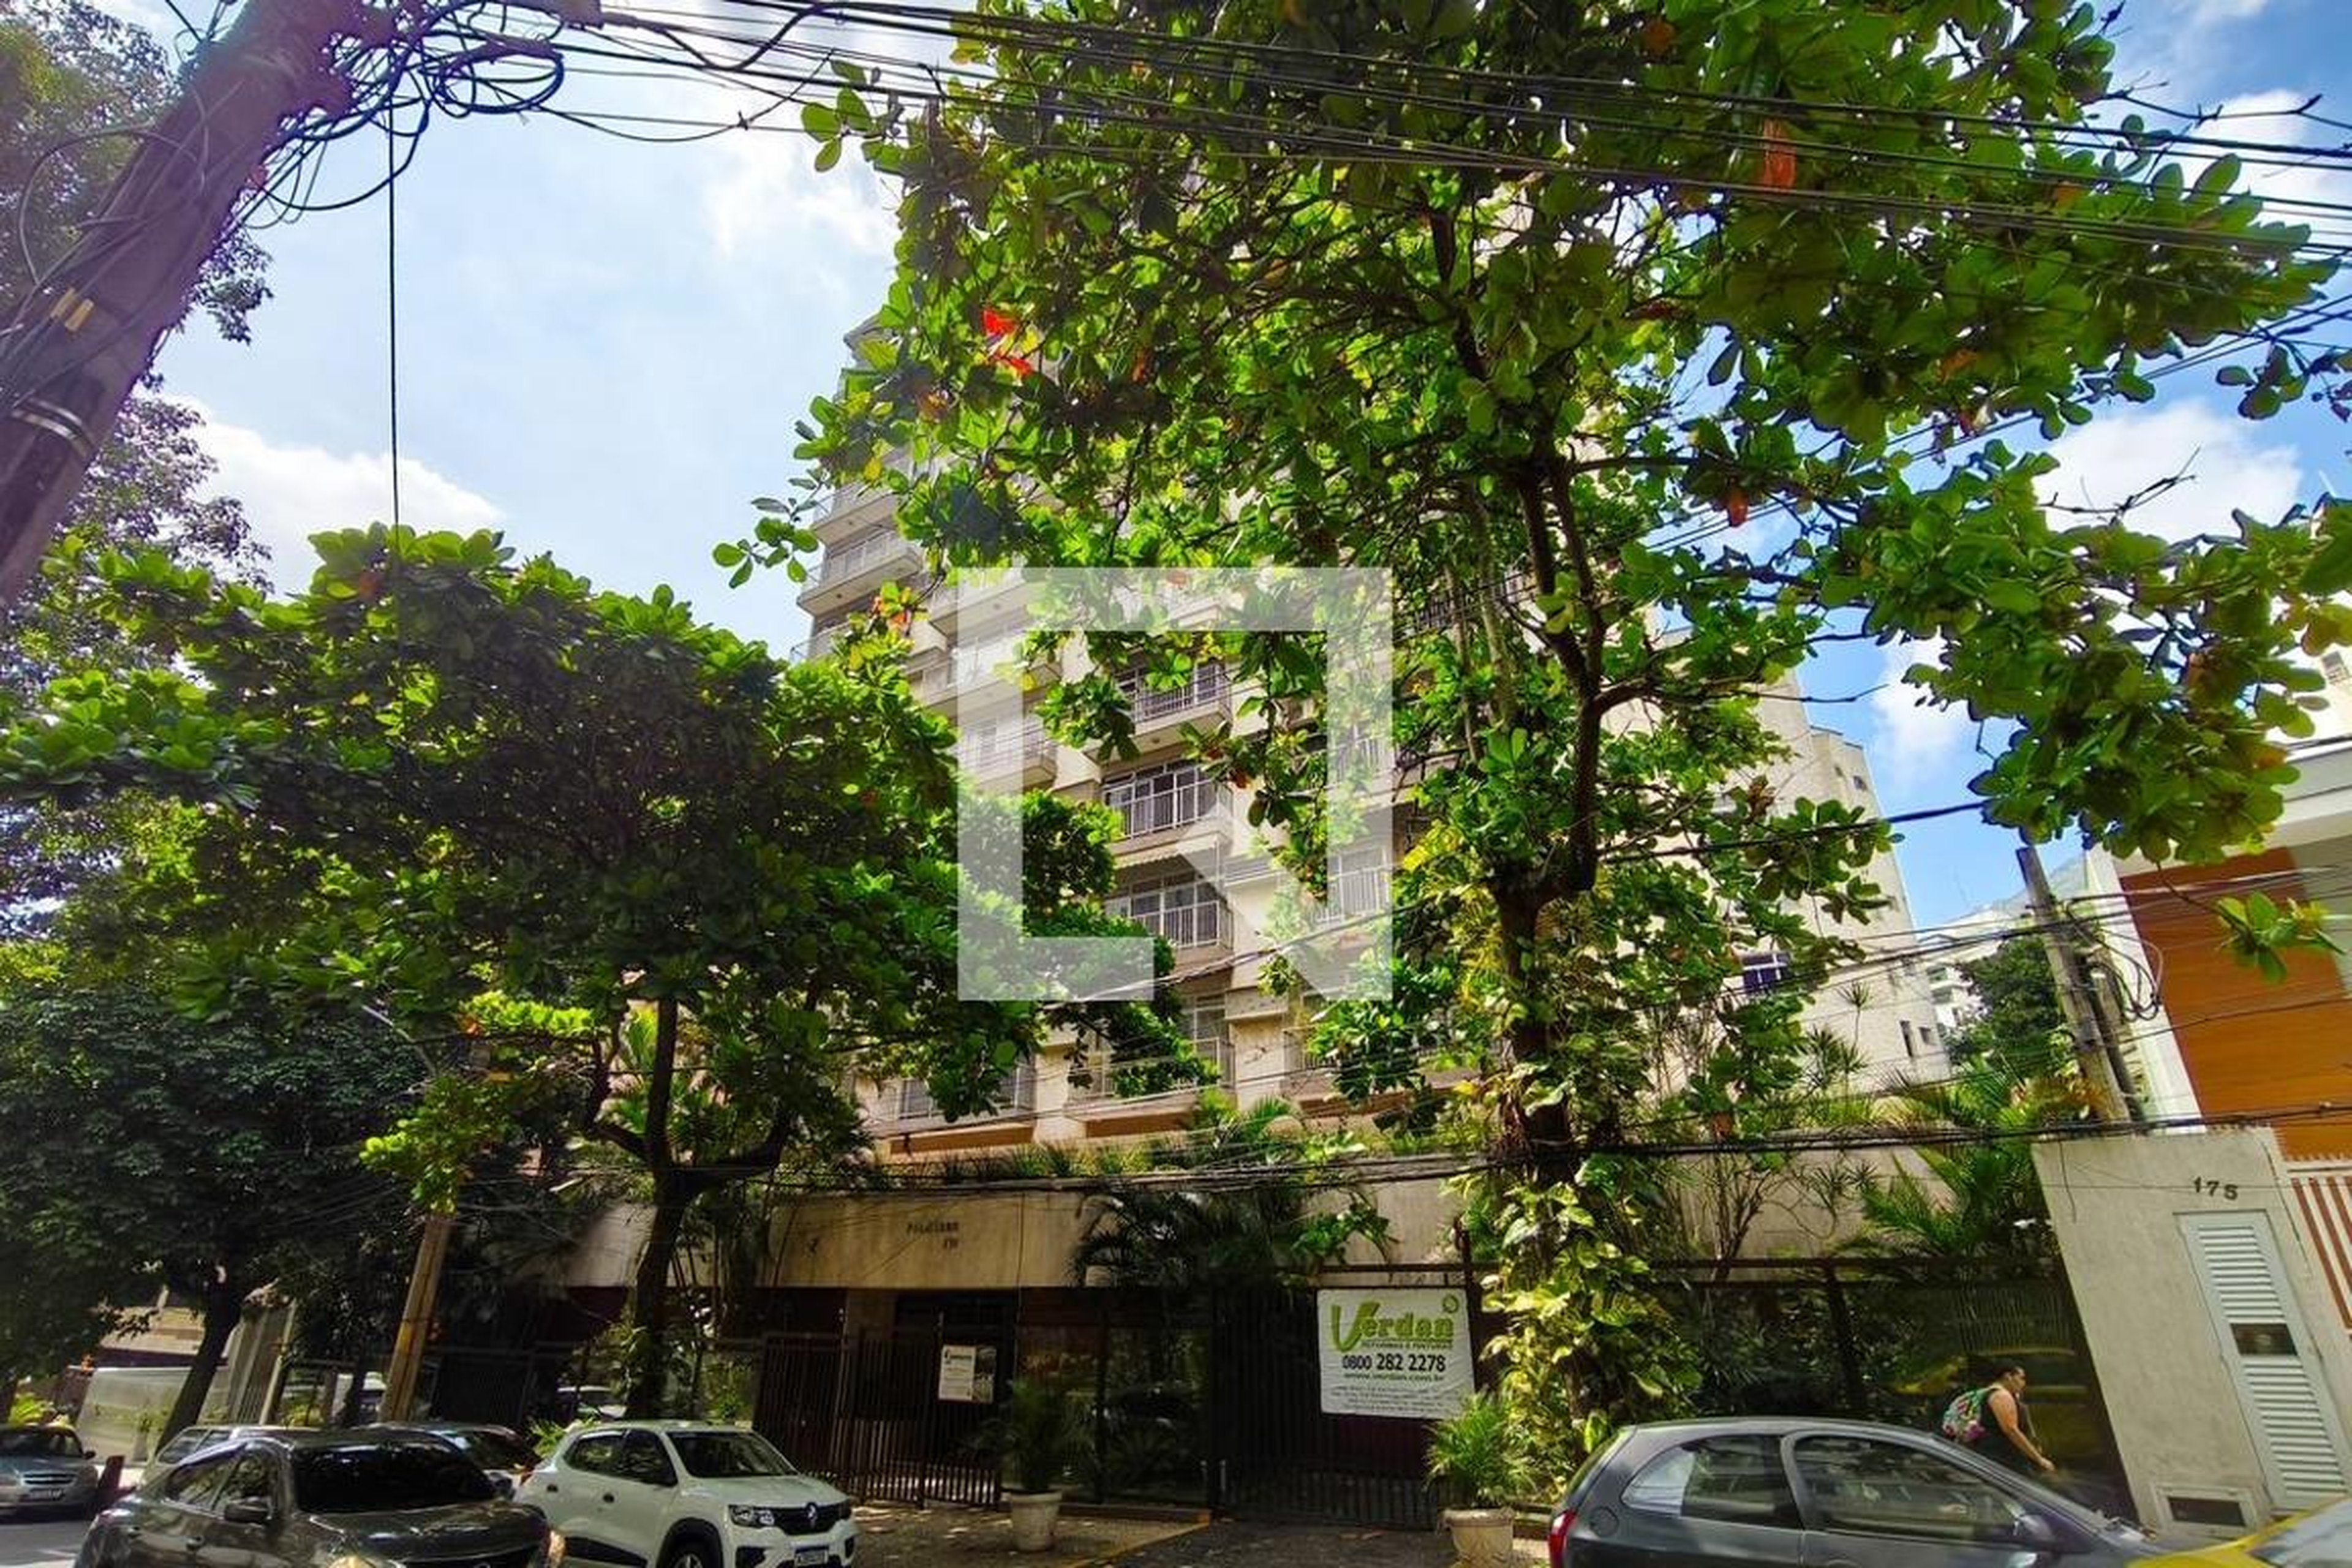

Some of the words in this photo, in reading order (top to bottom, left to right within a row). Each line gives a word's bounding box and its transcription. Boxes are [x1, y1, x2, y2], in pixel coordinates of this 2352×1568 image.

[1331, 1300, 1454, 1352] Verdan
[1342, 1354, 1373, 1370] 0800
[1376, 1352, 1404, 1371] 282
[1408, 1353, 1447, 1373] 2278
